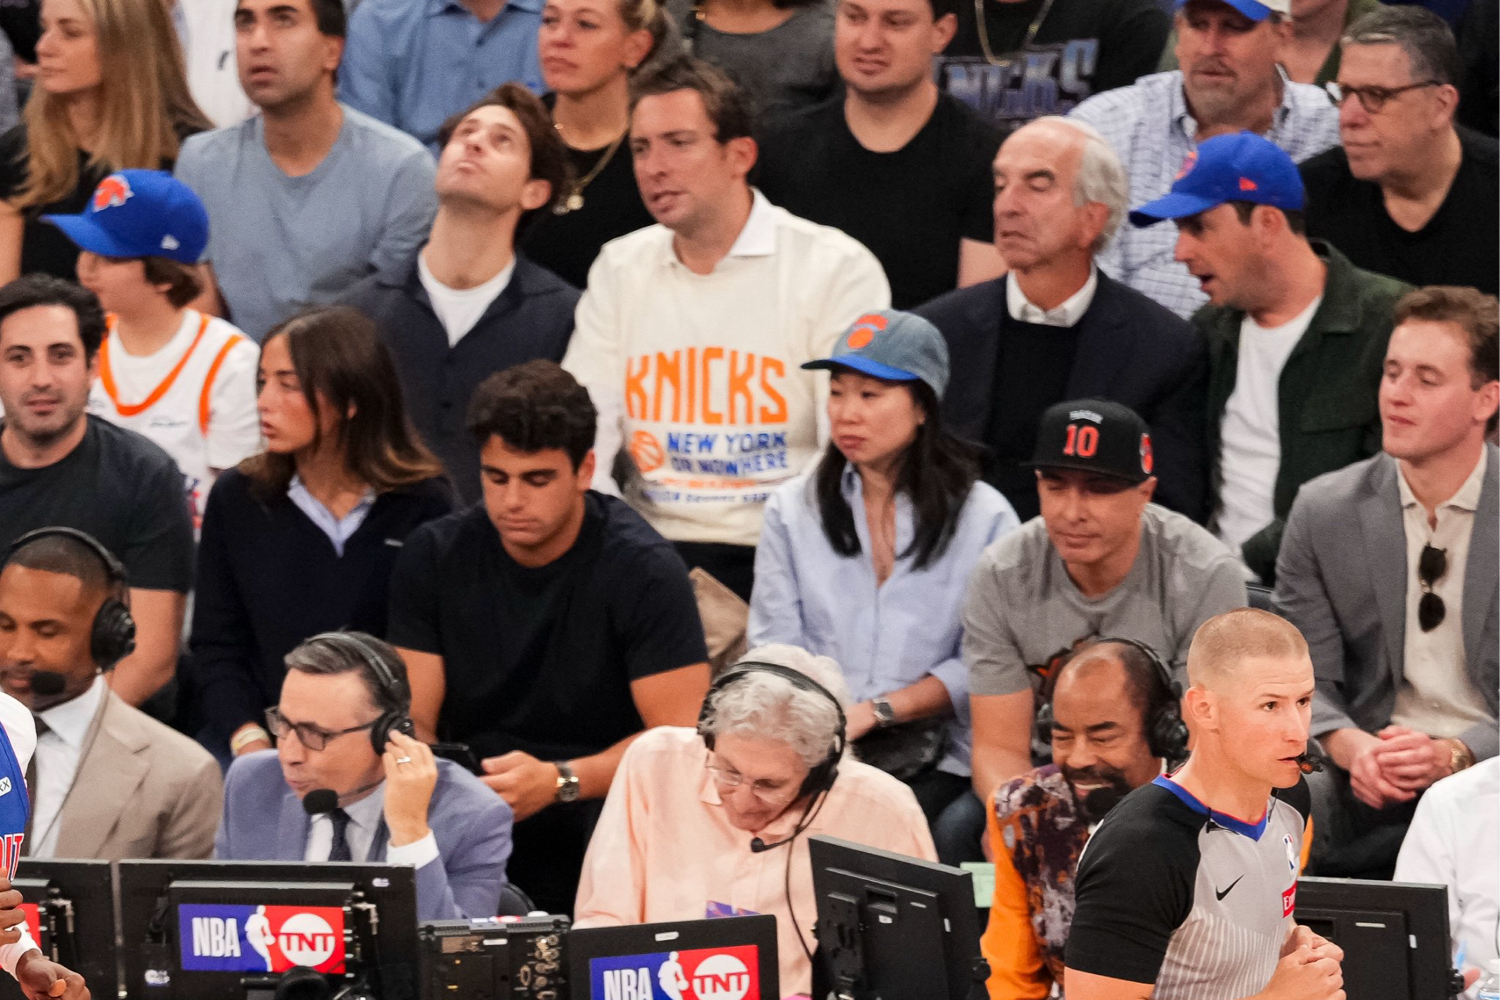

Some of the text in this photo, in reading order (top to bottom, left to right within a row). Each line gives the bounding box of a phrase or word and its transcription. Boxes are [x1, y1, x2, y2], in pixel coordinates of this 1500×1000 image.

[623, 346, 789, 425] KNICKS
[667, 431, 787, 454] NEW YORK
[1063, 424, 1099, 458] 10
[192, 917, 336, 957] NBA TNT
[693, 972, 749, 995] TNT
